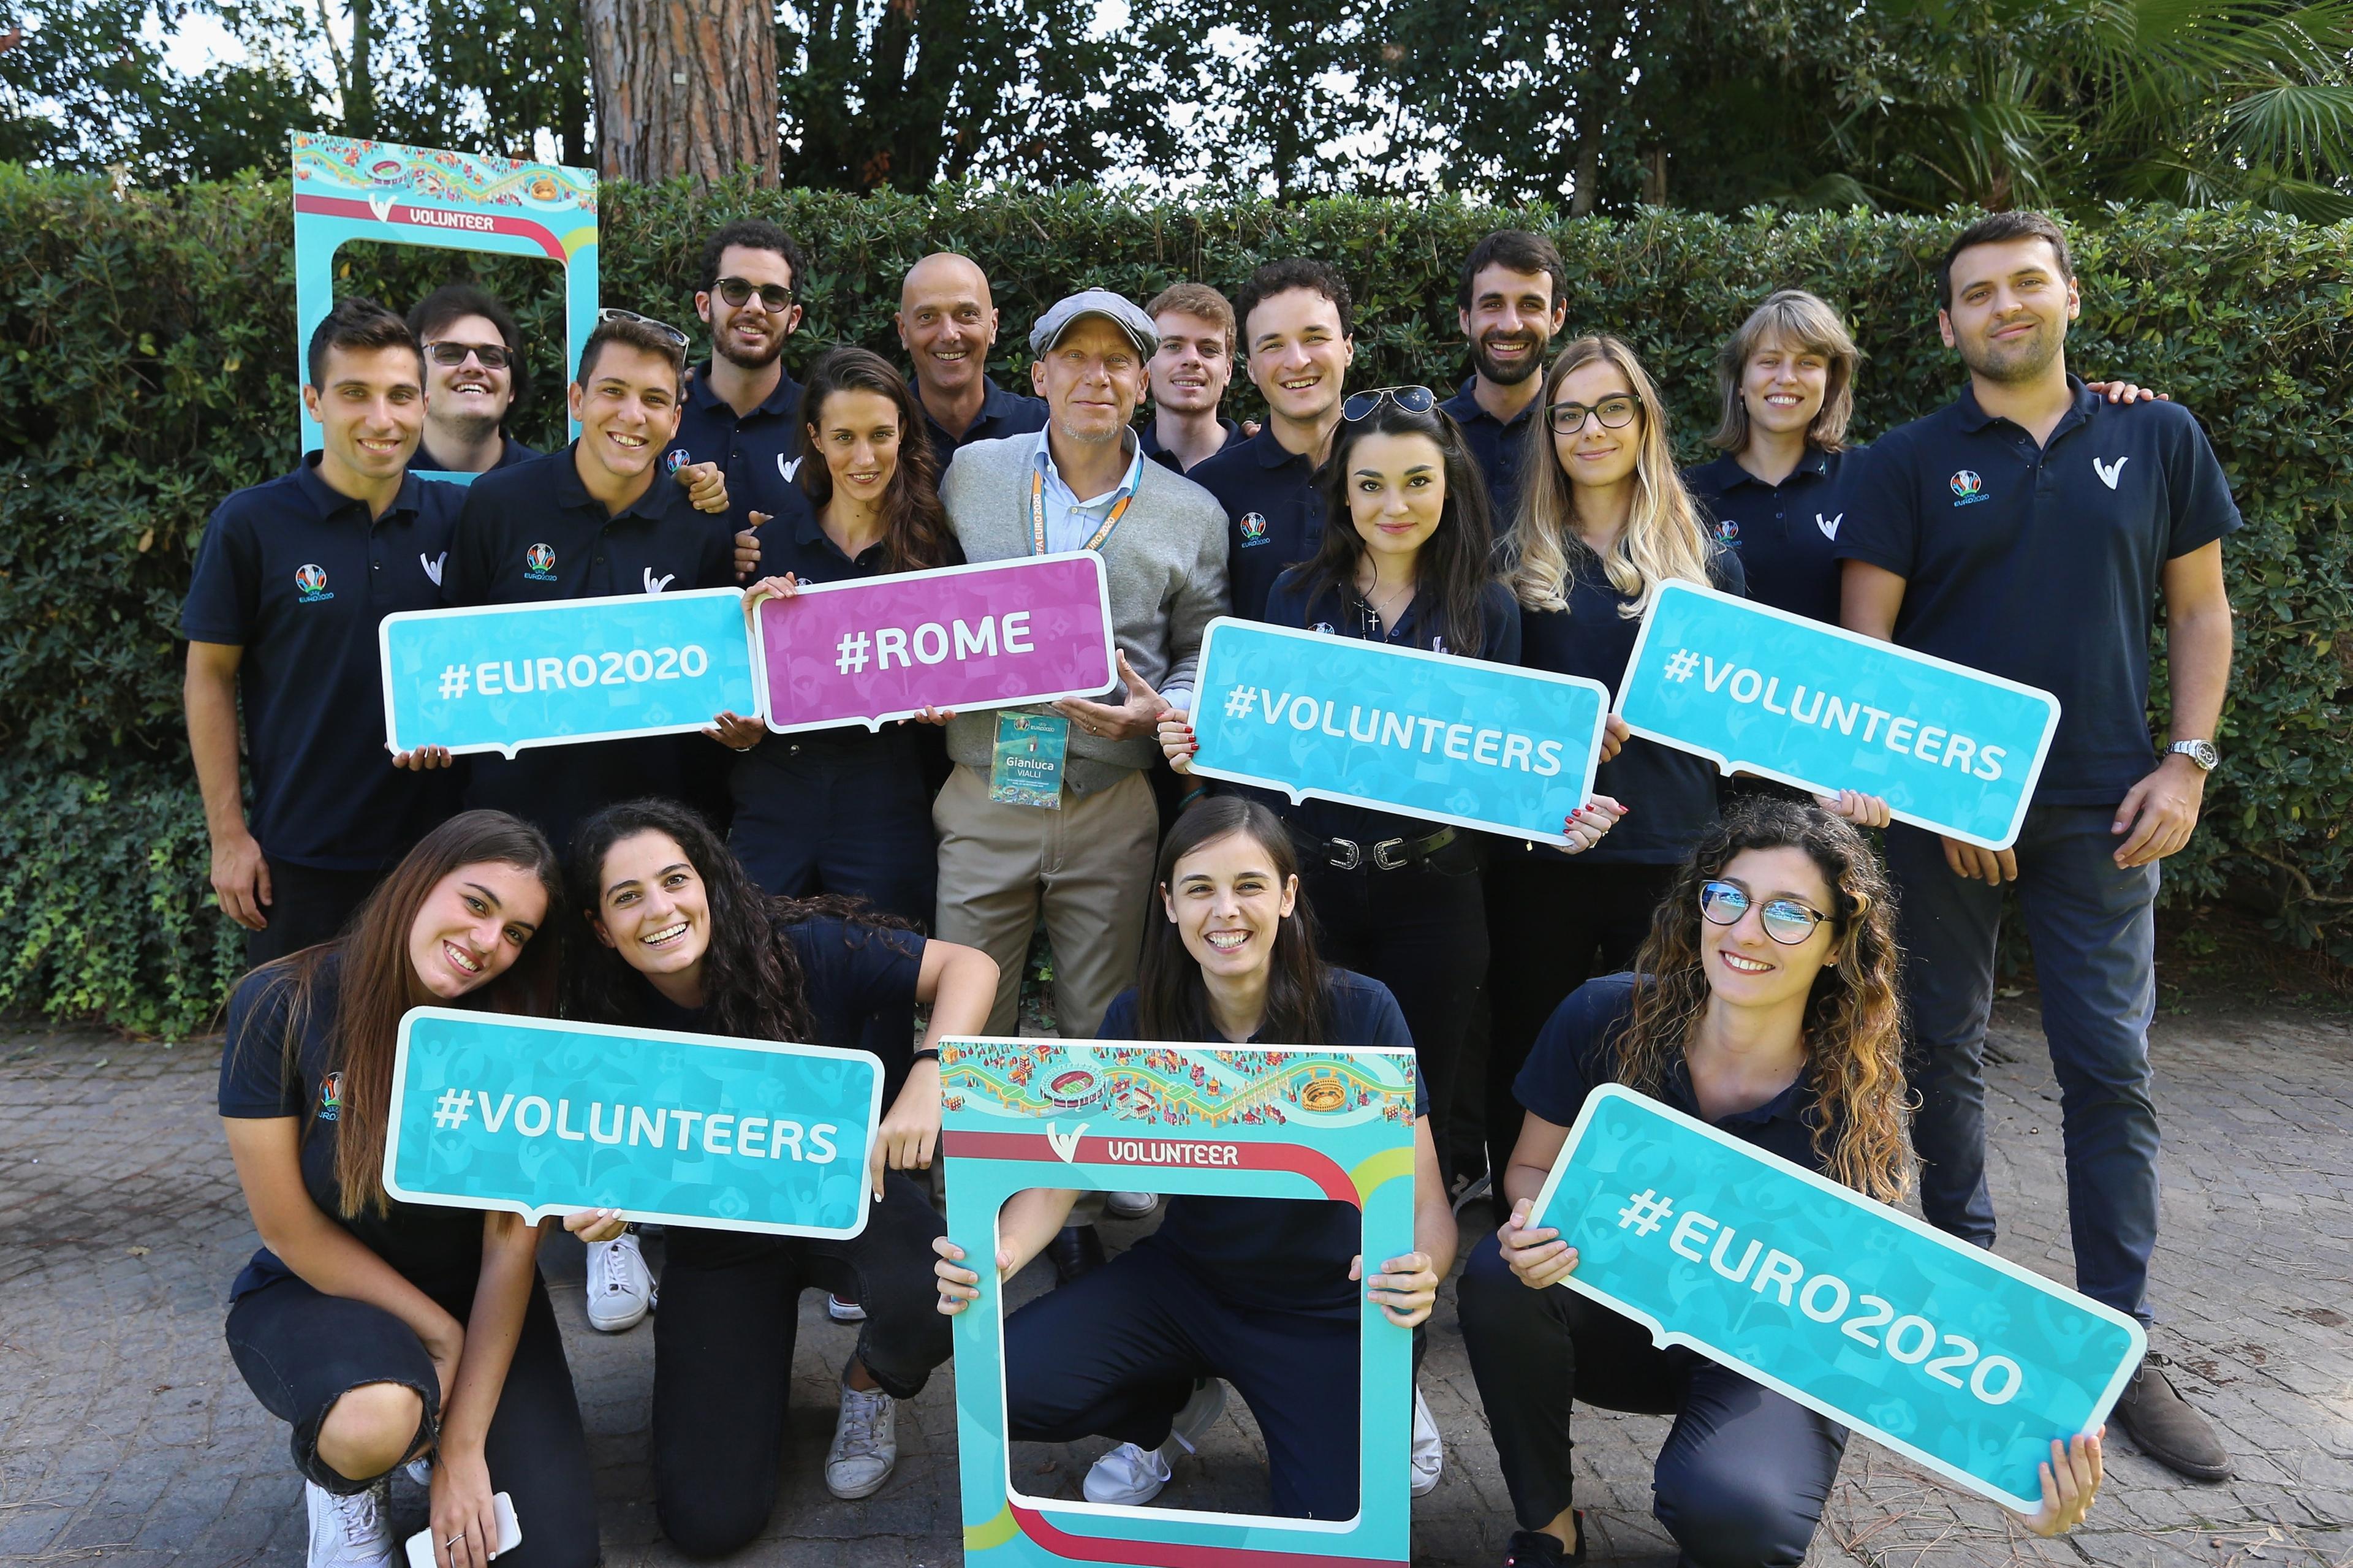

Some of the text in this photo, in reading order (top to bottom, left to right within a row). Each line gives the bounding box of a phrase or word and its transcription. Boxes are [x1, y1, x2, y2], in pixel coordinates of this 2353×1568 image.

[410, 208, 494, 230] VOLUNTEER
[1954, 494, 1990, 507] EURO2020
[1033, 493, 1045, 556] EFA EURO 2020
[1099, 517, 1115, 537] 2020
[1241, 537, 1271, 548] EURO2020
[524, 572, 558, 581] EURO2020
[835, 610, 1035, 675] #ROME
[438, 644, 709, 700] #EURO2020
[1664, 648, 2007, 781] #VOLUNTEERS
[1224, 684, 1564, 777] #VOLUNTEERS
[1006, 757, 1054, 770] Gianluca
[1017, 769, 1042, 778] VIALLI
[433, 1088, 838, 1164] #VOLUNTEERS
[1108, 1140, 1239, 1165] VOLUNTEER
[1618, 1188, 2023, 1405] #EURO2020
